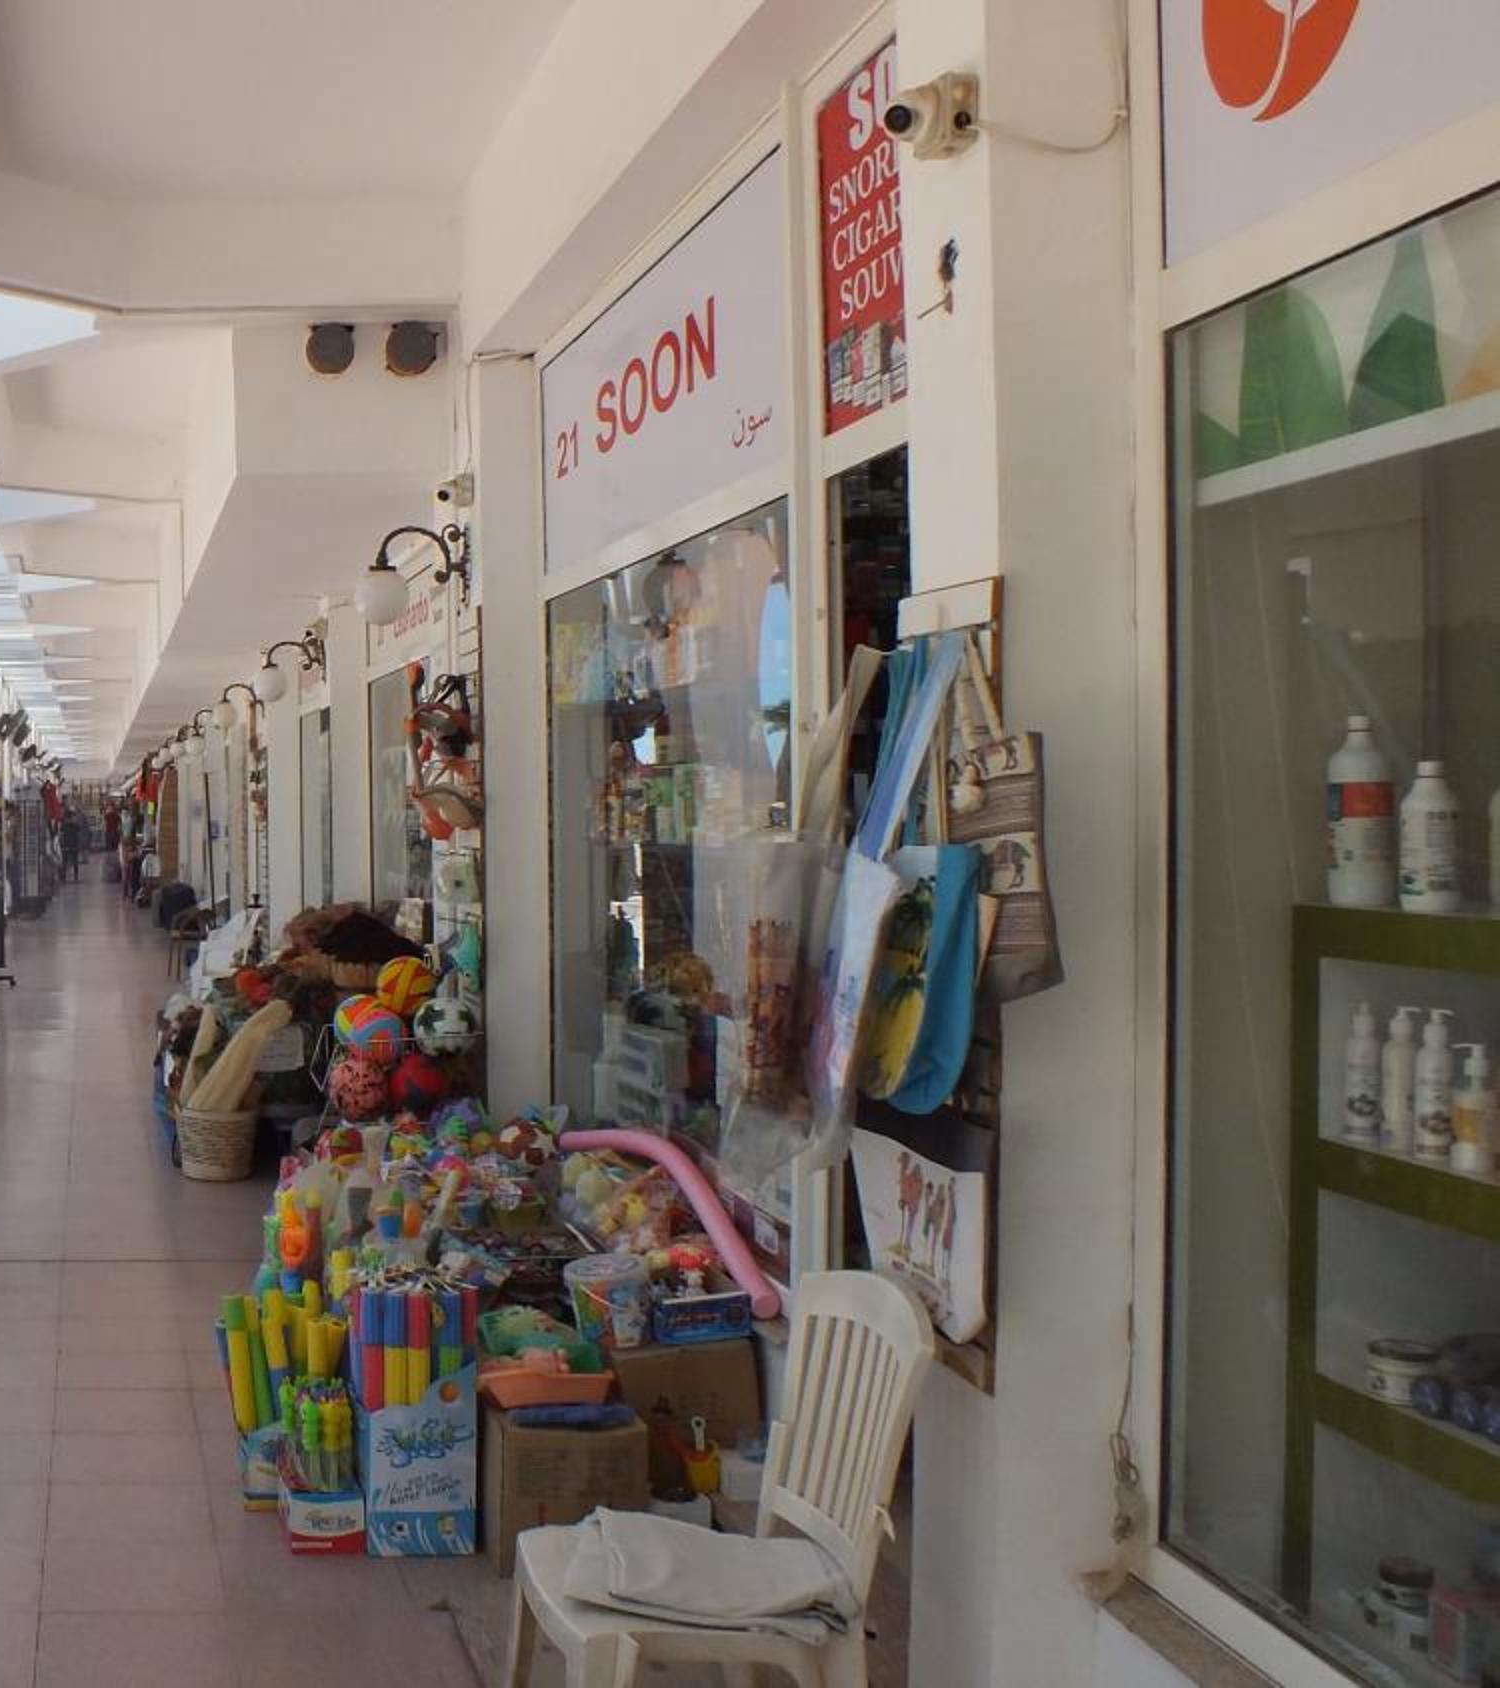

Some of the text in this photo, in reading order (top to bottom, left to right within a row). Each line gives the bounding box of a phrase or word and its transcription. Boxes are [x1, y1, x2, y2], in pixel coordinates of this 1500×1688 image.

[556, 295, 715, 479] 21 SOON
[731, 403, 773, 449] سون
